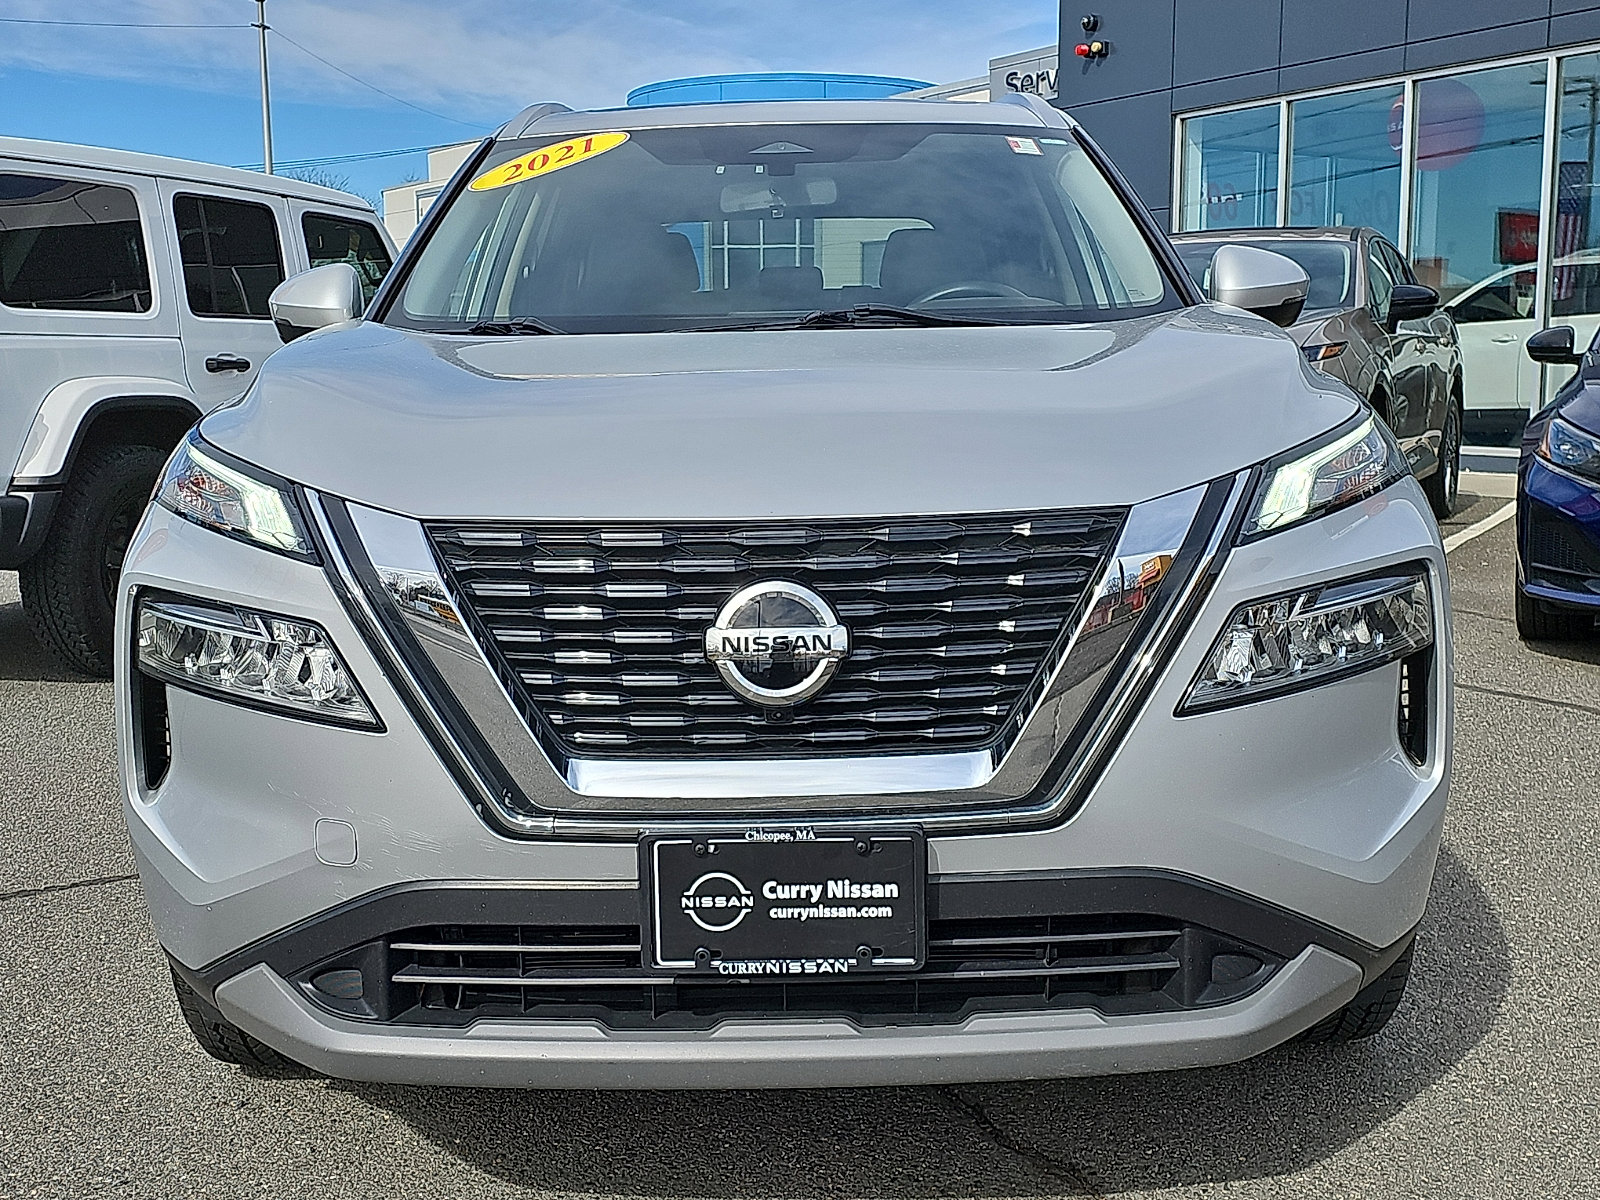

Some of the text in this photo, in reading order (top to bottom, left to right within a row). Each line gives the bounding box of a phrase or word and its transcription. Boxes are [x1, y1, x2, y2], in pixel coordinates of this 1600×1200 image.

[503, 138, 596, 183] 2021
[722, 634, 832, 653] NISSAN
[796, 829, 816, 840] MA
[762, 879, 899, 903] Curry Nissan
[681, 895, 754, 908] NISSAN
[769, 905, 893, 921] currynissan.com
